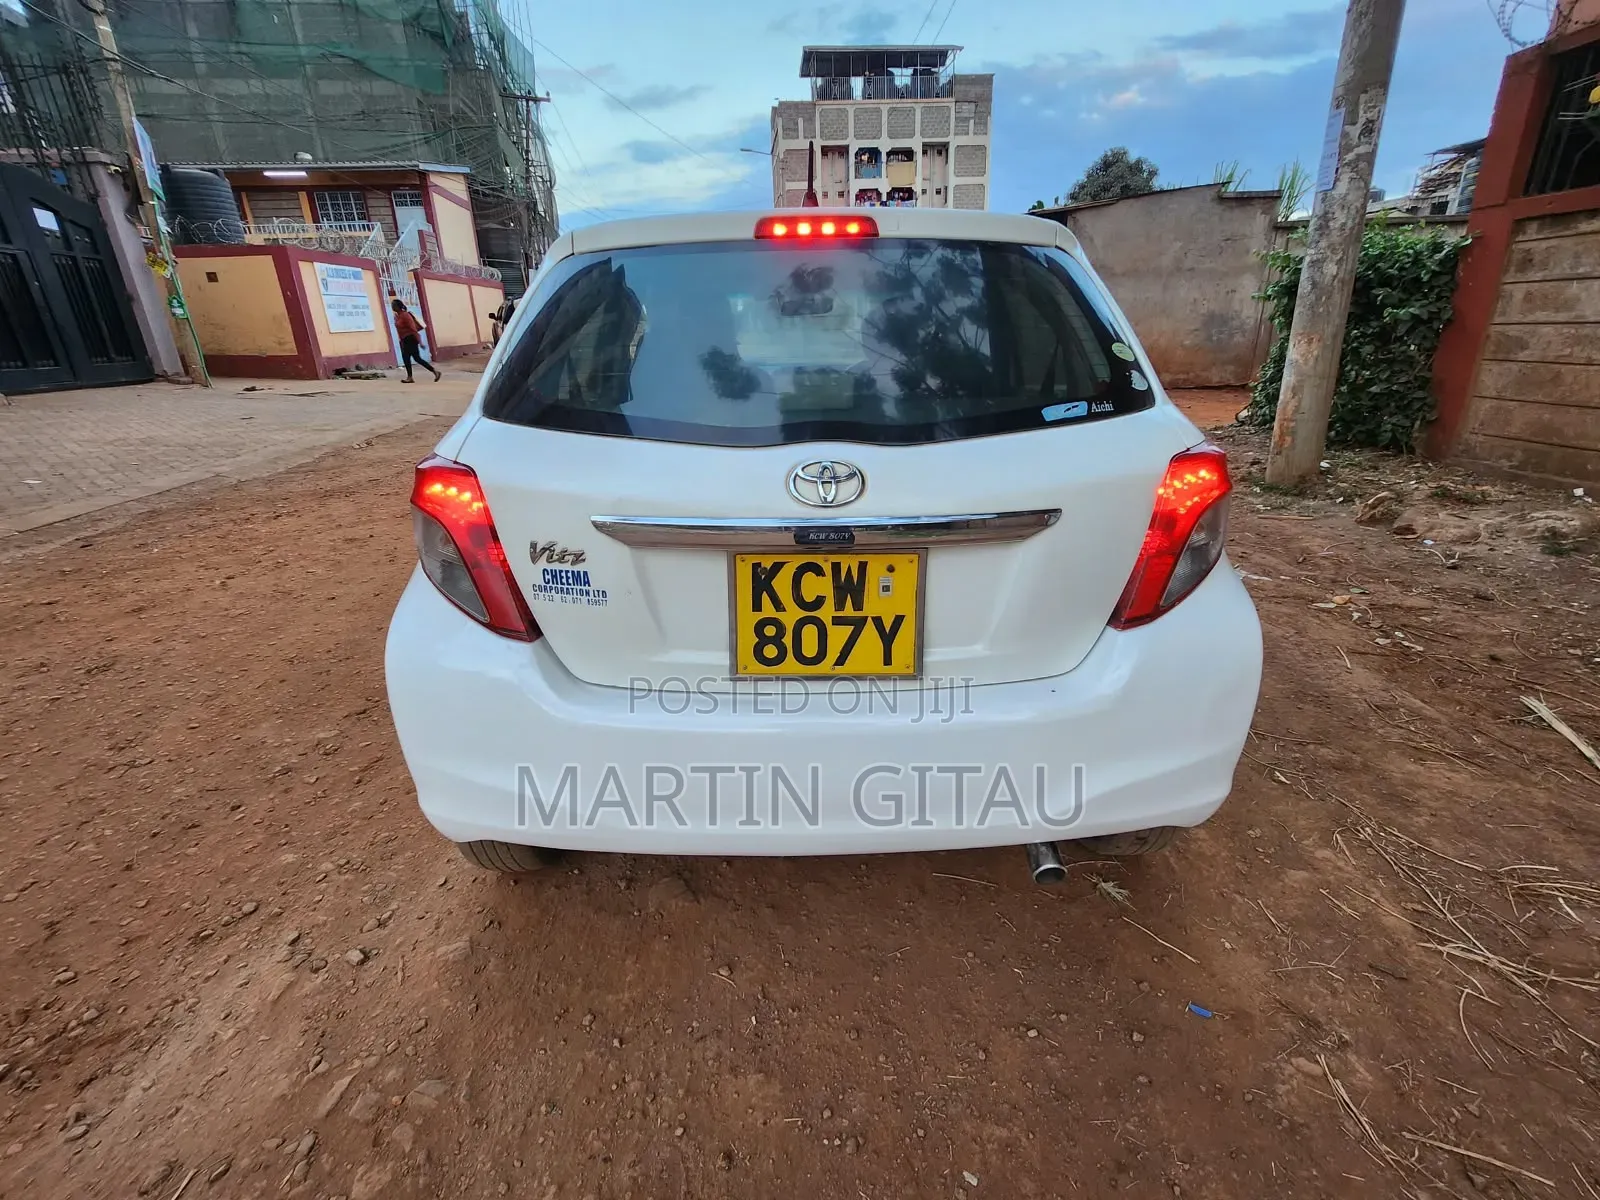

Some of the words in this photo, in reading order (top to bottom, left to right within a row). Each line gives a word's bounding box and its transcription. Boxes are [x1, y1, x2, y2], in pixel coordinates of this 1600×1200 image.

[1091, 401, 1114, 413] Aichi
[809, 532, 828, 540] KCW
[828, 532, 850, 540] 807Y
[529, 540, 586, 566] Vitz
[542, 568, 591, 587] CHEEMA
[751, 561, 868, 613] KCW
[532, 584, 590, 597] CORPORATION
[592, 589, 607, 598] LTD
[753, 615, 906, 667] 807Y
